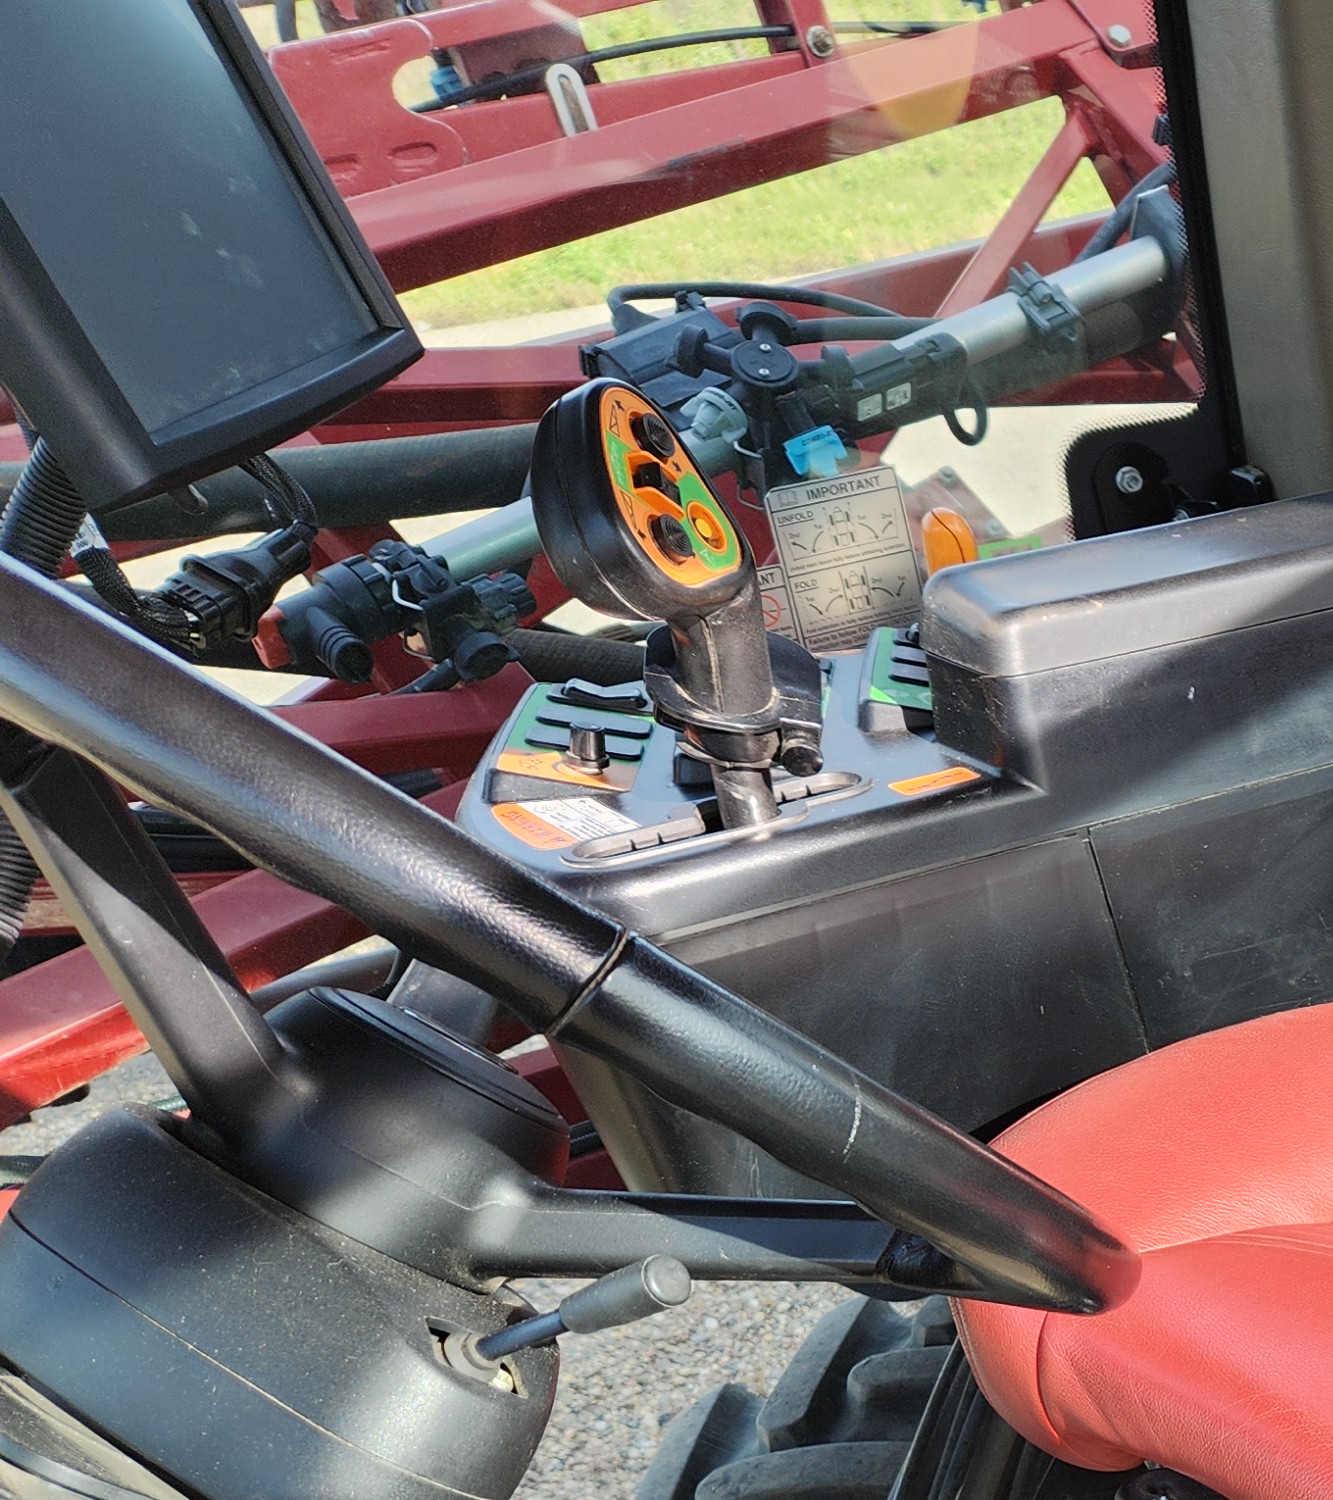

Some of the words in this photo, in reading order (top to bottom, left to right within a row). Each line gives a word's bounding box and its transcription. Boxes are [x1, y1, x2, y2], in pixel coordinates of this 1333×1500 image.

[806, 475, 881, 501] IMPORTANT
[778, 510, 814, 524] UNFOLD
[794, 578, 818, 590] FOLD
